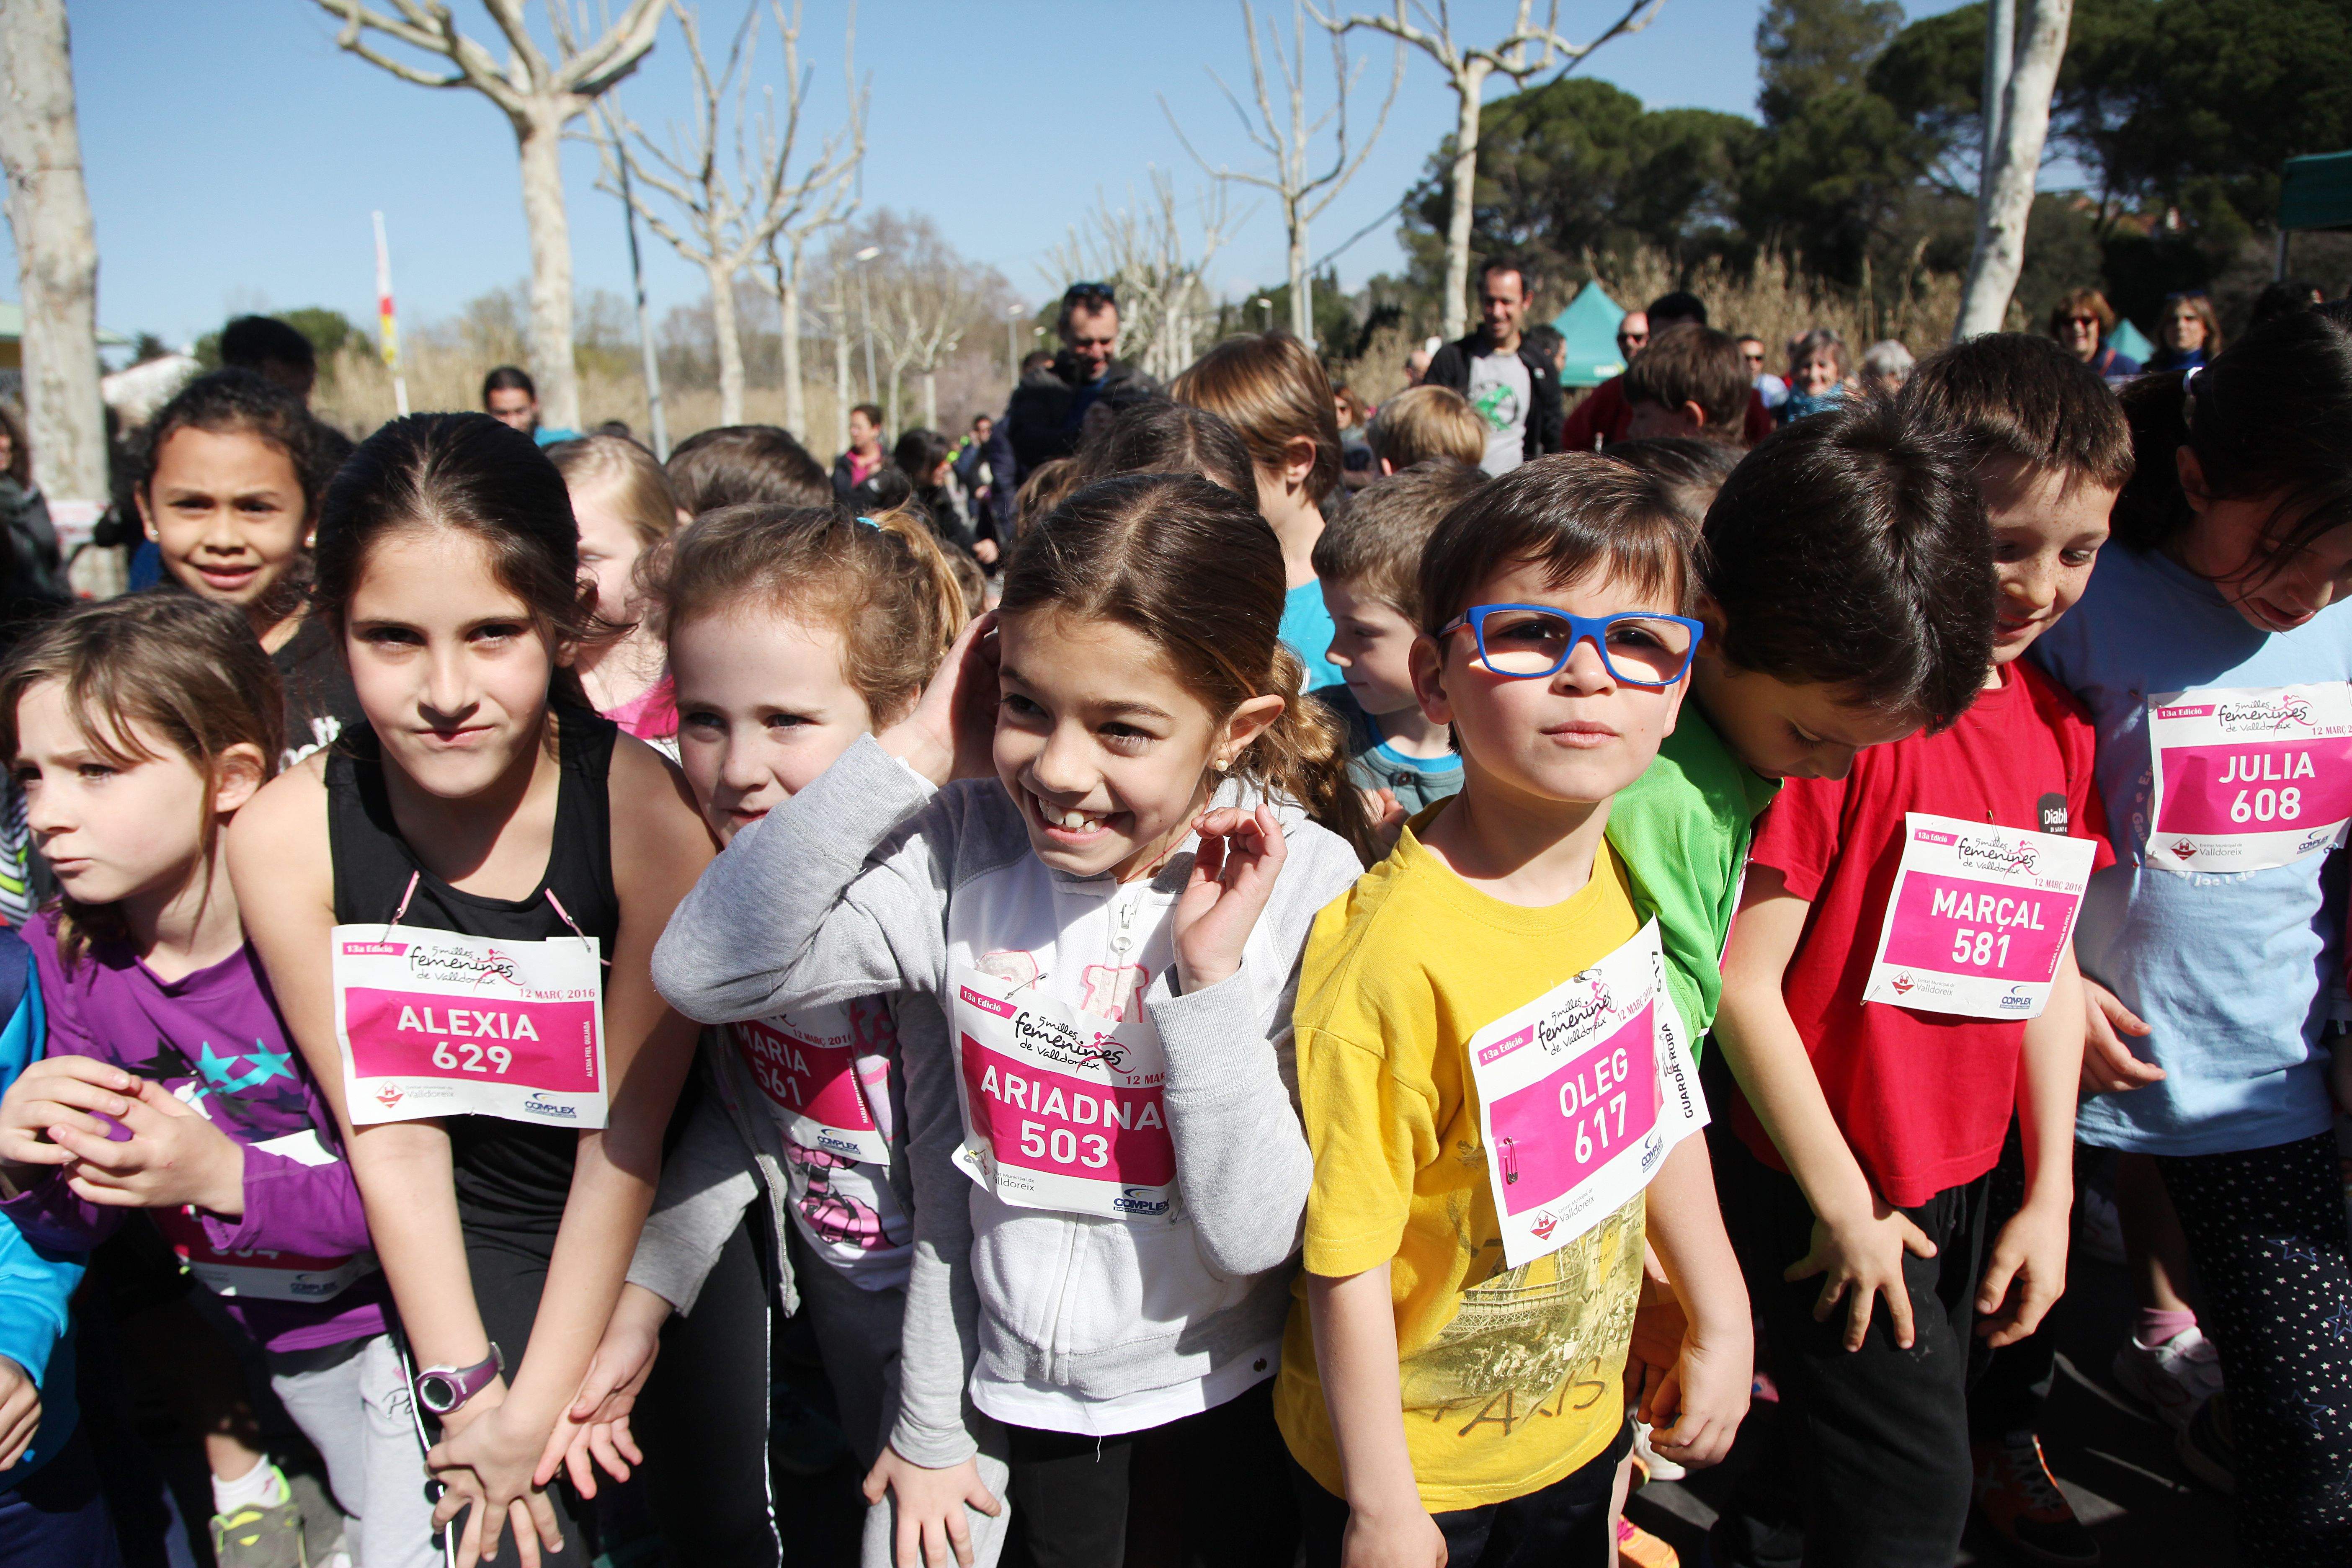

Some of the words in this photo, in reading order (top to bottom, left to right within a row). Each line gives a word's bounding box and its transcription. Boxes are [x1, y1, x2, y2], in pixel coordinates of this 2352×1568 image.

[2178, 708, 2202, 716] Edició
[2218, 704, 2308, 727] femenines
[2226, 723, 2236, 732] de
[2240, 722, 2291, 732] Valldoreix
[2312, 727, 2323, 735] 12
[2326, 725, 2347, 736] MARÇ
[2218, 751, 2315, 784] JULIA
[2231, 787, 2300, 823] 608
[1930, 832, 1947, 843] Edició
[1958, 838, 2036, 868] femenines
[1963, 857, 1973, 868] de
[1977, 861, 2020, 874] Valldoreix
[2035, 878, 2043, 887] 12
[2045, 879, 2063, 891] MARÇ
[2065, 882, 2082, 892] 2016
[1931, 888, 2045, 933] MARÇAL
[410, 946, 513, 978] femenines
[1952, 928, 2011, 968] 581
[416, 970, 431, 980] de
[520, 988, 531, 998] 12
[535, 990, 564, 1002] MARÇ
[567, 989, 595, 998] 2016
[963, 990, 976, 1003] 13a
[977, 997, 1001, 1013] Edició
[1617, 1009, 1626, 1023] 12
[1627, 999, 1643, 1015] MARÇ
[1643, 984, 1653, 1003] 2016
[1917, 984, 1952, 996] Valldoreix
[2002, 996, 2032, 1005] COMPLEX
[397, 1005, 540, 1042] ALEXIA
[1538, 990, 1612, 1050] femenines
[736, 1022, 811, 1078] MARIA
[793, 1029, 802, 1039] 12
[804, 1033, 826, 1047] MARÇ
[1015, 1012, 1124, 1065] femenines
[1482, 1049, 1499, 1060] 13a
[1500, 1034, 1524, 1055] Edició
[1551, 1042, 1561, 1055] de
[1563, 1017, 1607, 1047] Valldoreix
[432, 1041, 512, 1074] 629
[1020, 1038, 1033, 1051] de
[1037, 1045, 1100, 1070] Valldoreix
[754, 1057, 802, 1106] 561
[1126, 1075, 1140, 1085] 12
[1560, 1047, 1629, 1117] OLEG
[1662, 1023, 1693, 1118] GUARDA-ROBA
[525, 1101, 575, 1114] COMPLEX
[980, 1065, 1163, 1130] ARIADNA
[859, 1106, 869, 1123] MARIA
[1575, 1090, 1627, 1164] 617
[1020, 1119, 1109, 1168] 503
[1003, 1173, 1026, 1181] Municipal
[1114, 1198, 1169, 1211] COMPLEX
[1559, 1196, 1594, 1222] Valldoreix
